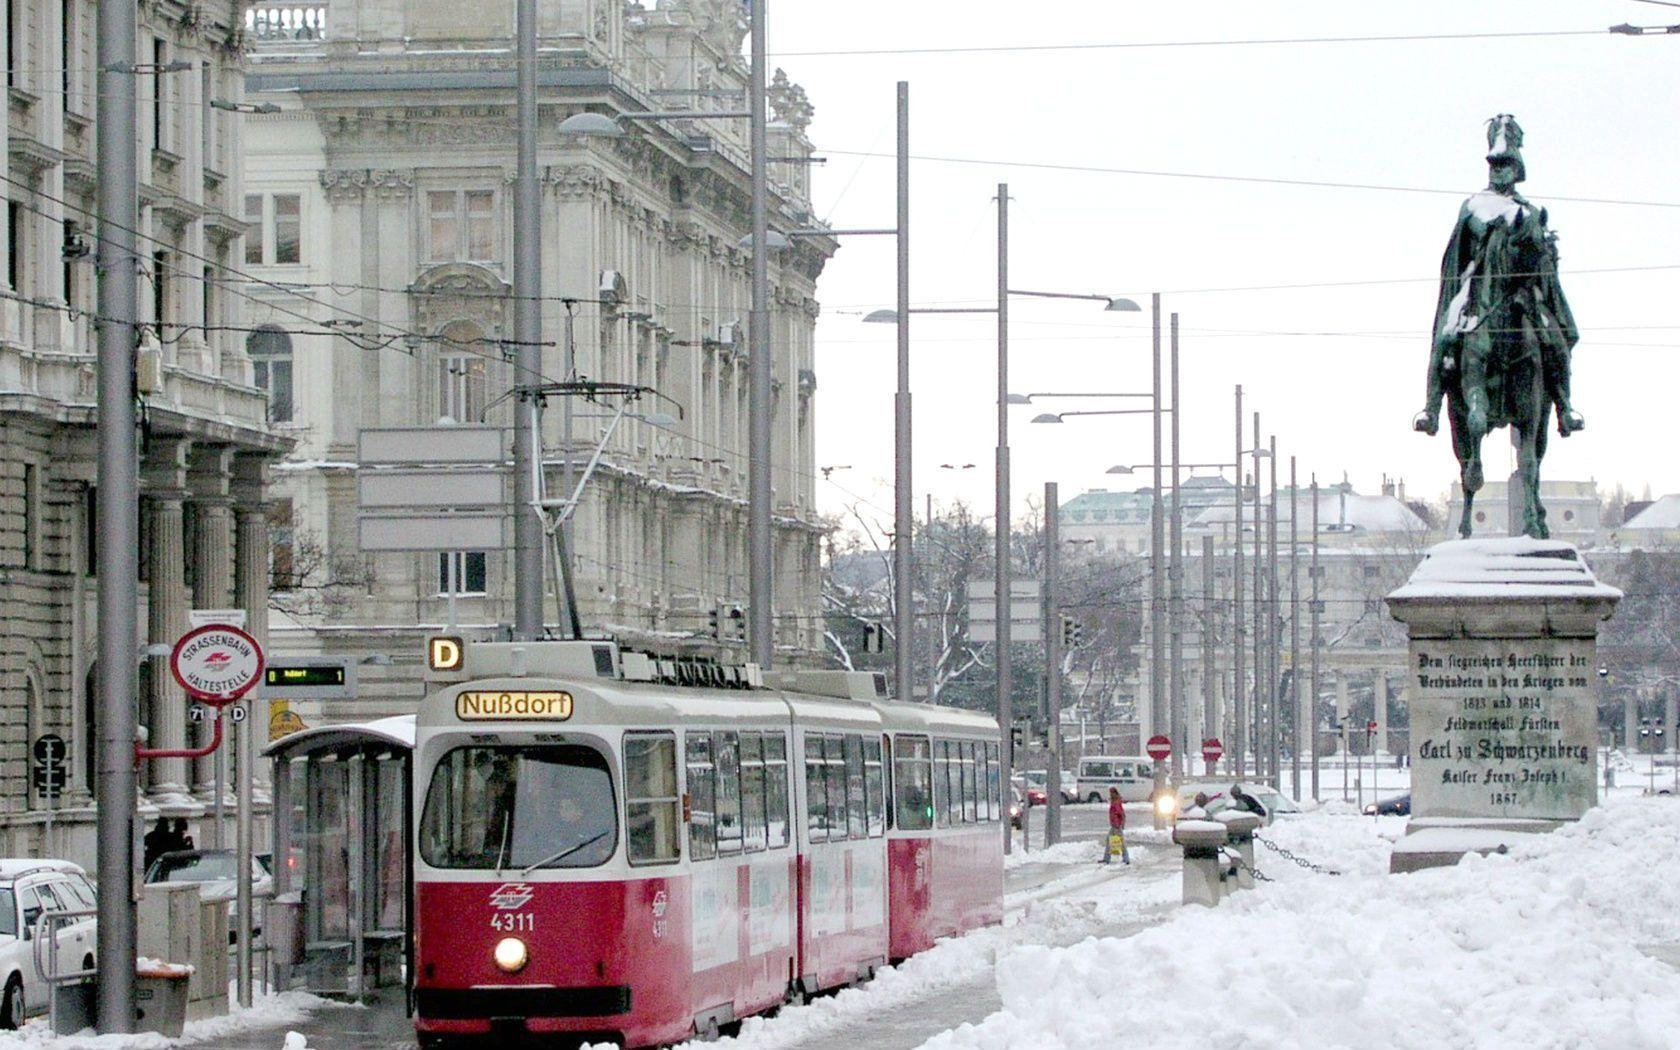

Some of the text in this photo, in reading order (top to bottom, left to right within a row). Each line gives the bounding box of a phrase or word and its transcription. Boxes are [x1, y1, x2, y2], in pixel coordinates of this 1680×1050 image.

[183, 634, 251, 661] STRASSENBAHN
[434, 640, 459, 668] D
[1417, 652, 1443, 668] Dem
[1570, 653, 1587, 668] der
[187, 669, 250, 692] HALTESTELLE
[1417, 674, 1588, 691] Verbündeten in den Kriegen von
[462, 693, 568, 714] Nußdorf
[1493, 695, 1512, 709] und
[1518, 696, 1541, 710] 1814
[190, 707, 205, 720] 71
[233, 707, 245, 720] D
[1419, 738, 1589, 765] Carl zu Schwarzenberg
[1442, 768, 1477, 787] Kaiser
[1483, 768, 1516, 786] Franz
[489, 912, 535, 932] 4311
